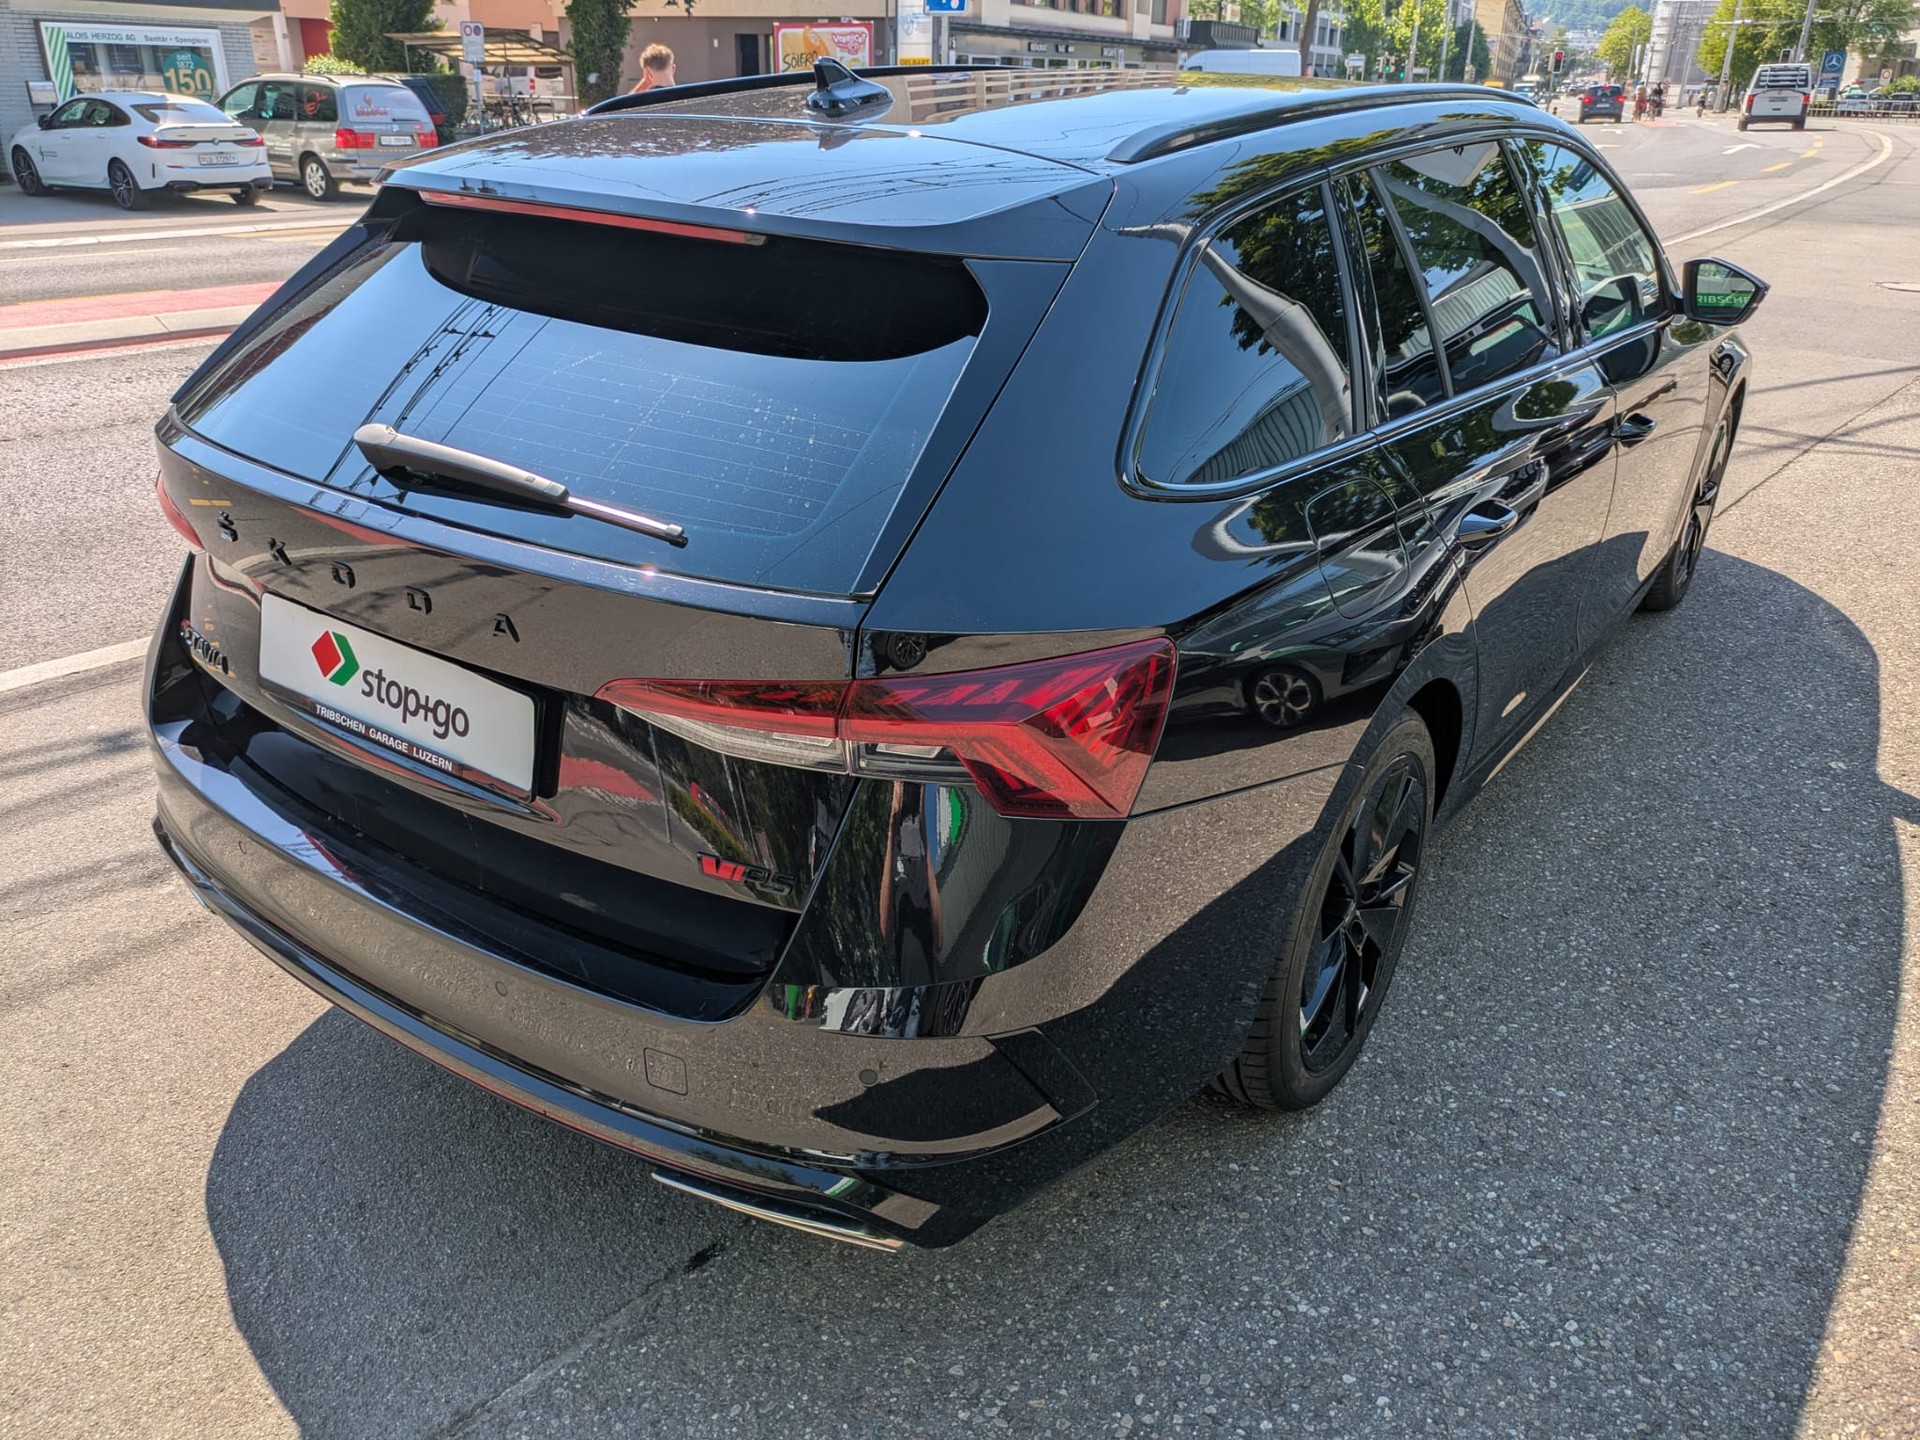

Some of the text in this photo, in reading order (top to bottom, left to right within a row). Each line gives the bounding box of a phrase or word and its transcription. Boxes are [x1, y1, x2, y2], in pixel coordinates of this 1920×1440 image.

[66, 31, 136, 41] ALOIS HERZOG AG
[174, 35, 209, 45] Spenglerei
[176, 61, 195, 69] 1872
[164, 67, 212, 96] 150
[361, 669, 470, 740] stop+go
[315, 704, 453, 772] TRIBSCHEN GARAGE LUZERN
